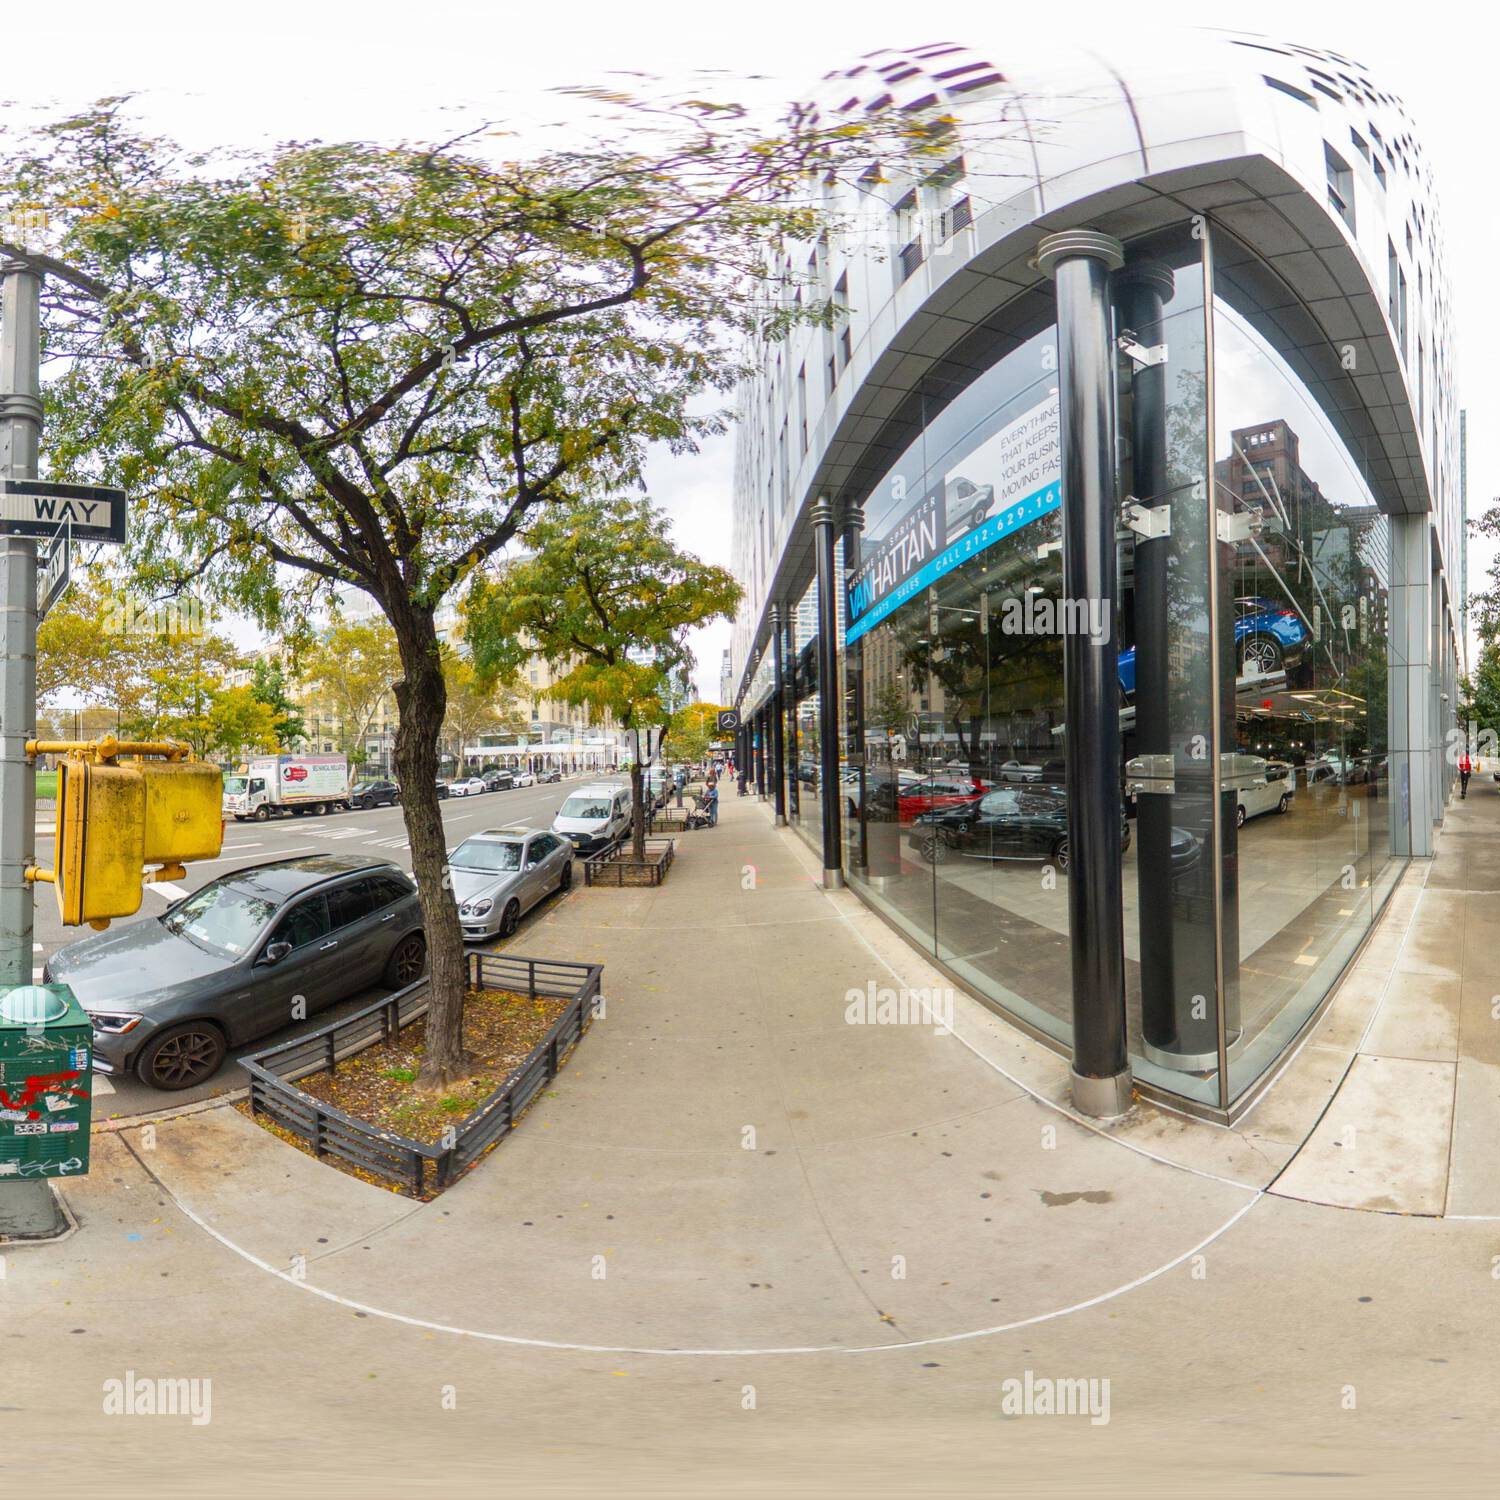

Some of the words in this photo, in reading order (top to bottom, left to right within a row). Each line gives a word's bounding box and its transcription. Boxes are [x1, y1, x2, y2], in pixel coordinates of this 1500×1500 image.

[1000, 404, 1060, 449] EVERYTHING
[1001, 443, 1022, 465] THAT
[1025, 420, 1058, 449] KEEPS
[1001, 458, 1026, 481] YOUR
[1002, 468, 1040, 500] MOVING
[34, 498, 98, 523] WAY
[849, 558, 874, 590] WELCOME
[877, 546, 886, 559] TO
[889, 495, 936, 546] SPRINTER
[849, 510, 937, 620] VANHATTAN
[896, 576, 921, 600] SALES
[935, 547, 961, 572] CALL
